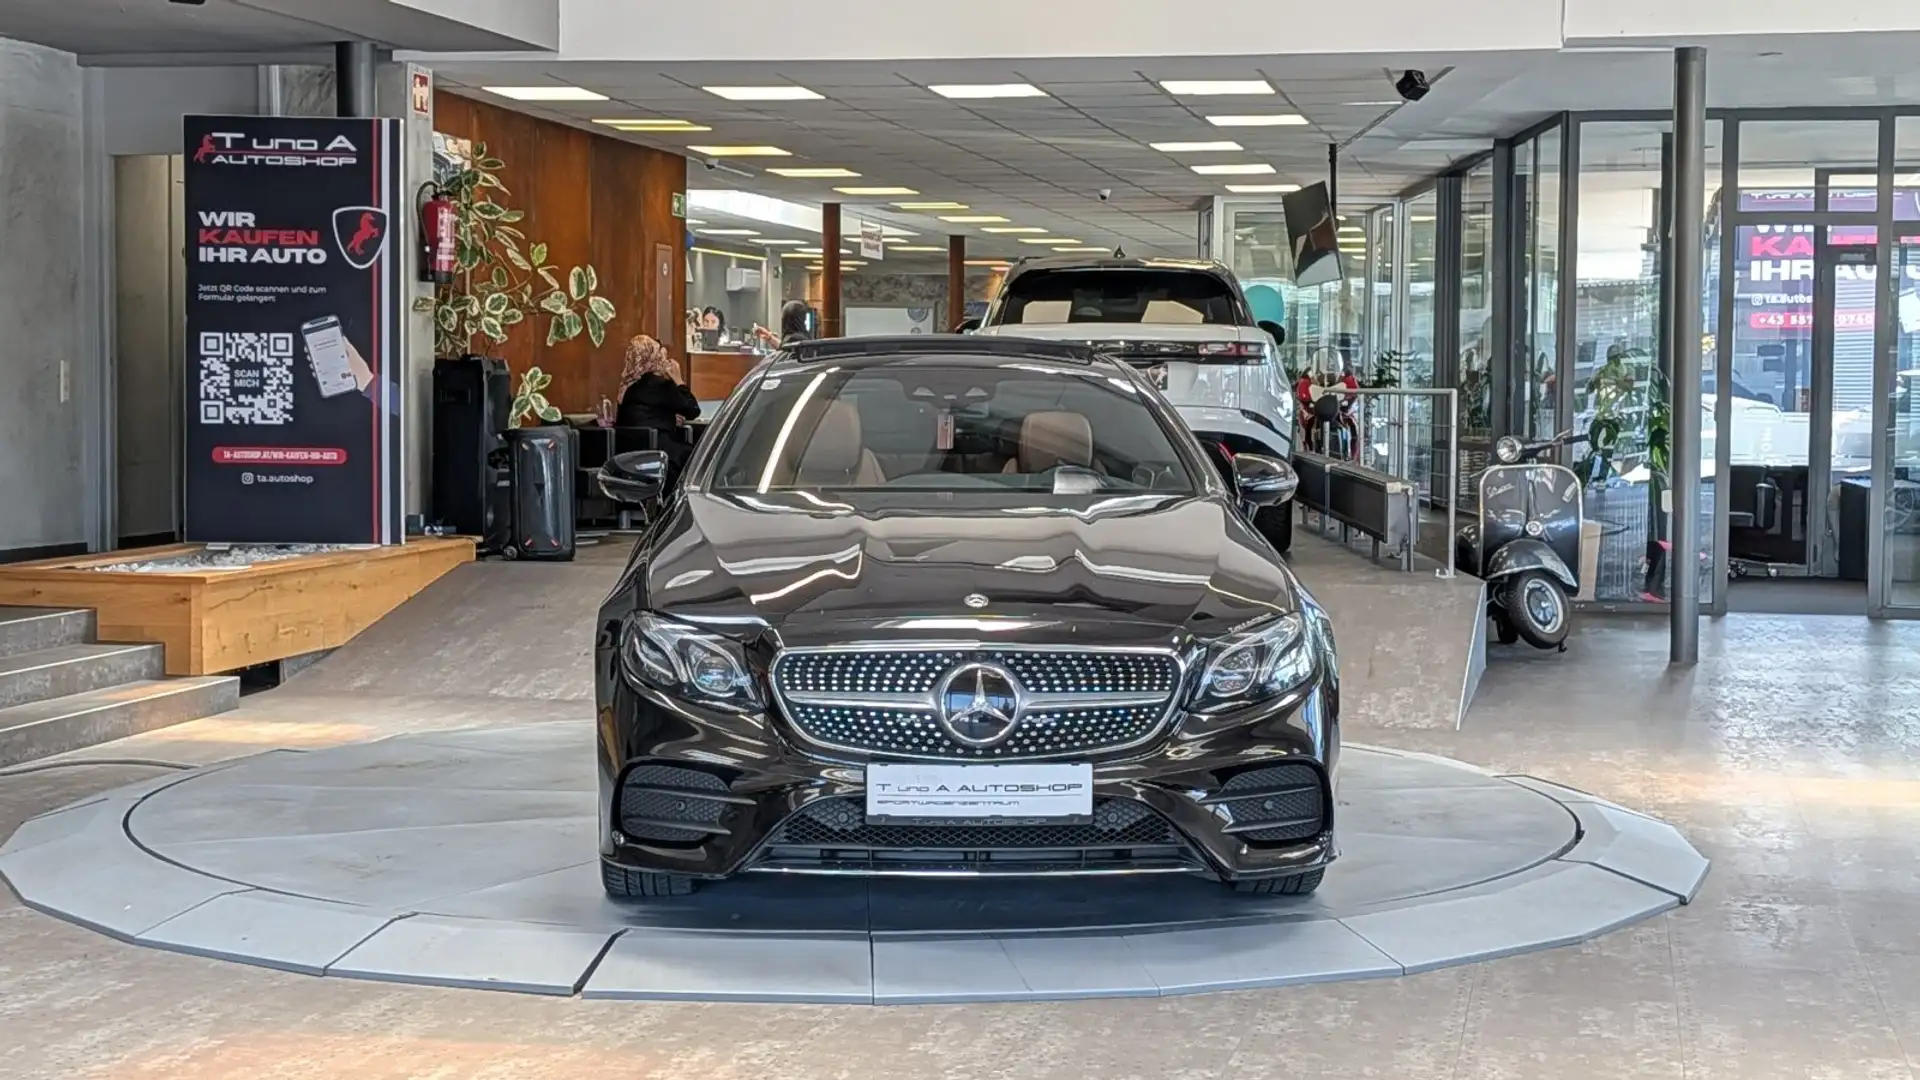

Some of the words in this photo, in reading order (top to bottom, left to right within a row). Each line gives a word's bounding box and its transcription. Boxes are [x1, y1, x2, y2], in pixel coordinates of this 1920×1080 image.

[211, 132, 245, 148] T
[324, 134, 358, 152] A
[211, 155, 358, 166] AUTOSHOP
[198, 211, 256, 227] WIR
[198, 229, 319, 245] KAUFEN
[198, 247, 247, 262] IHR
[250, 249, 328, 265] AUTO
[233, 285, 254, 293] Code
[198, 293, 235, 301] Formular
[234, 370, 259, 378] SCAN
[234, 379, 259, 387] MICH
[257, 475, 314, 484] ta.autoshop
[876, 783, 891, 792] T
[936, 784, 950, 792] A
[958, 783, 1083, 792] AUTOSHOP
